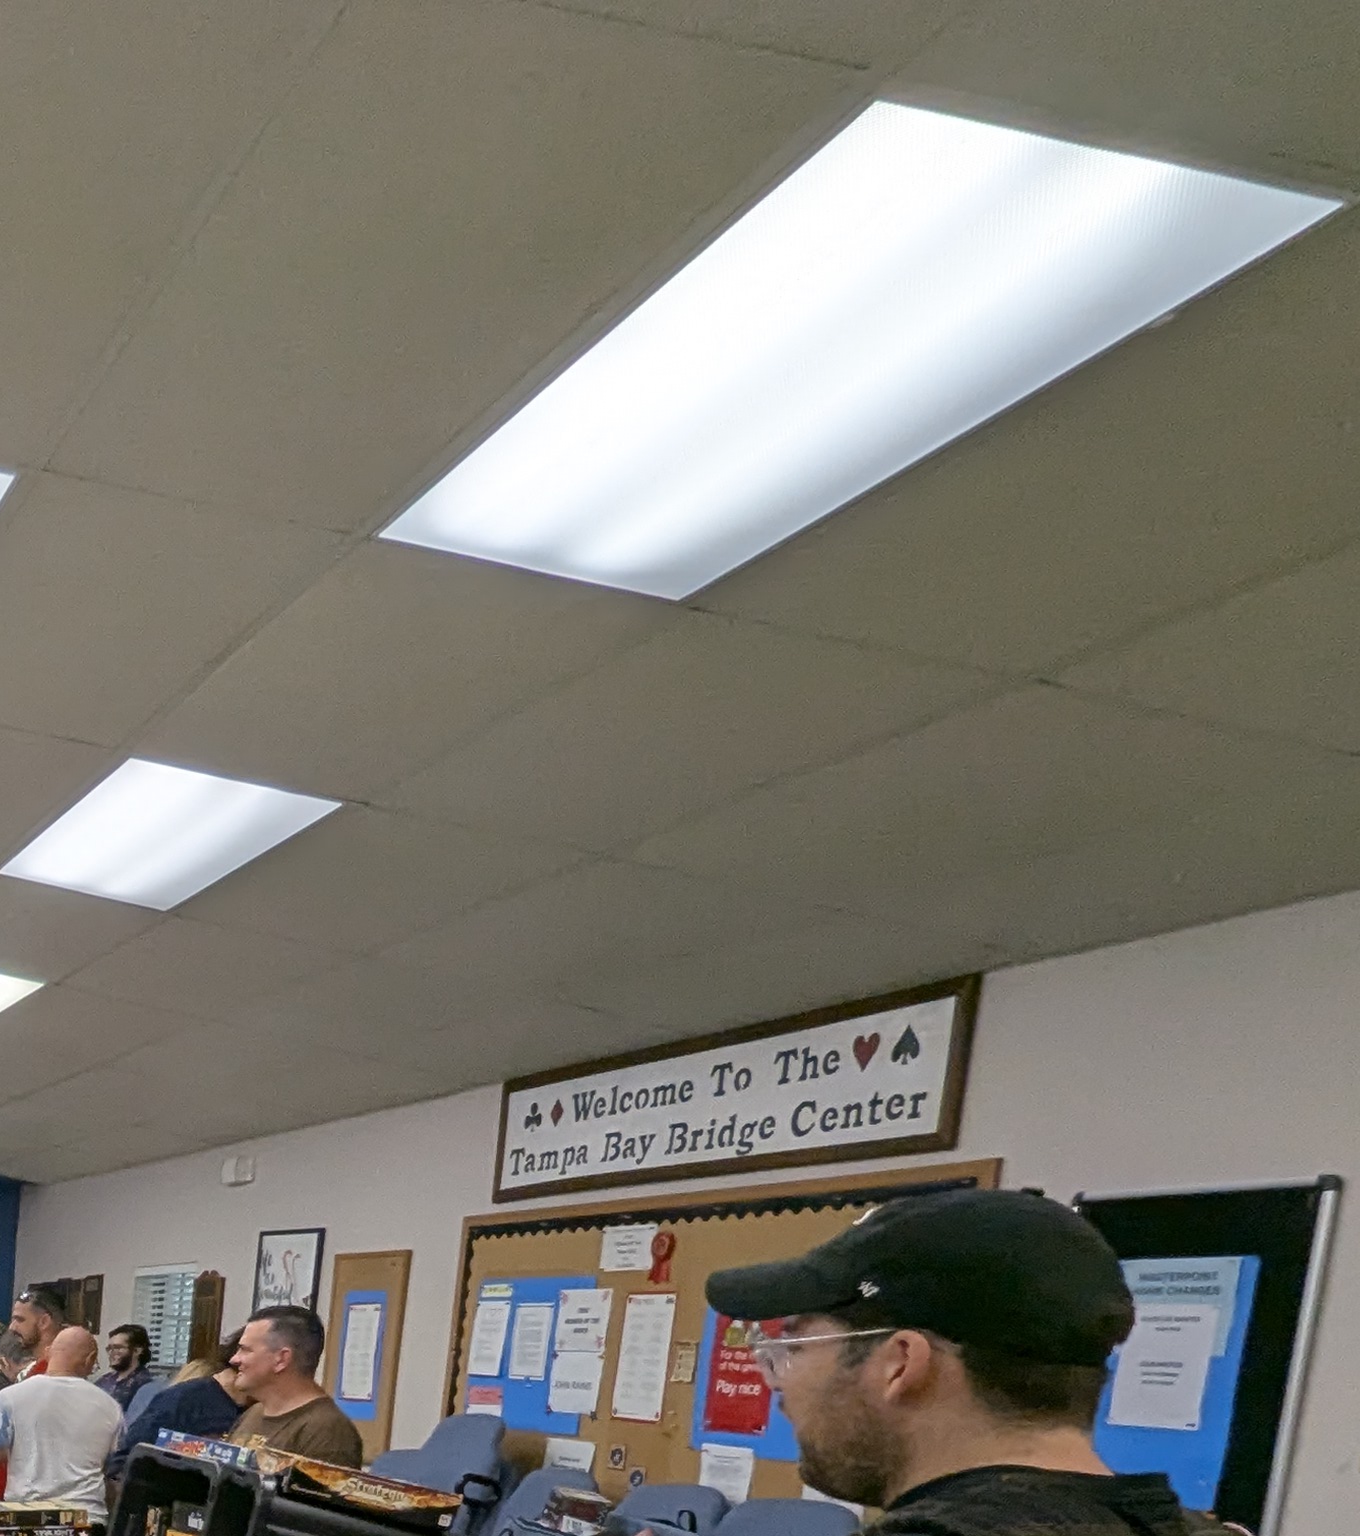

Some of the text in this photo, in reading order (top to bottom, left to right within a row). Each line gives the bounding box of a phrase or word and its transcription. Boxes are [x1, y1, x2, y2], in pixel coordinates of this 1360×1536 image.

[572, 1045, 841, 1124] Welcome To The
[509, 1090, 930, 1177] Tampa Bay Bridge Center
[716, 1380, 761, 1397] Play nice
[347, 1476, 410, 1501] Stratego
